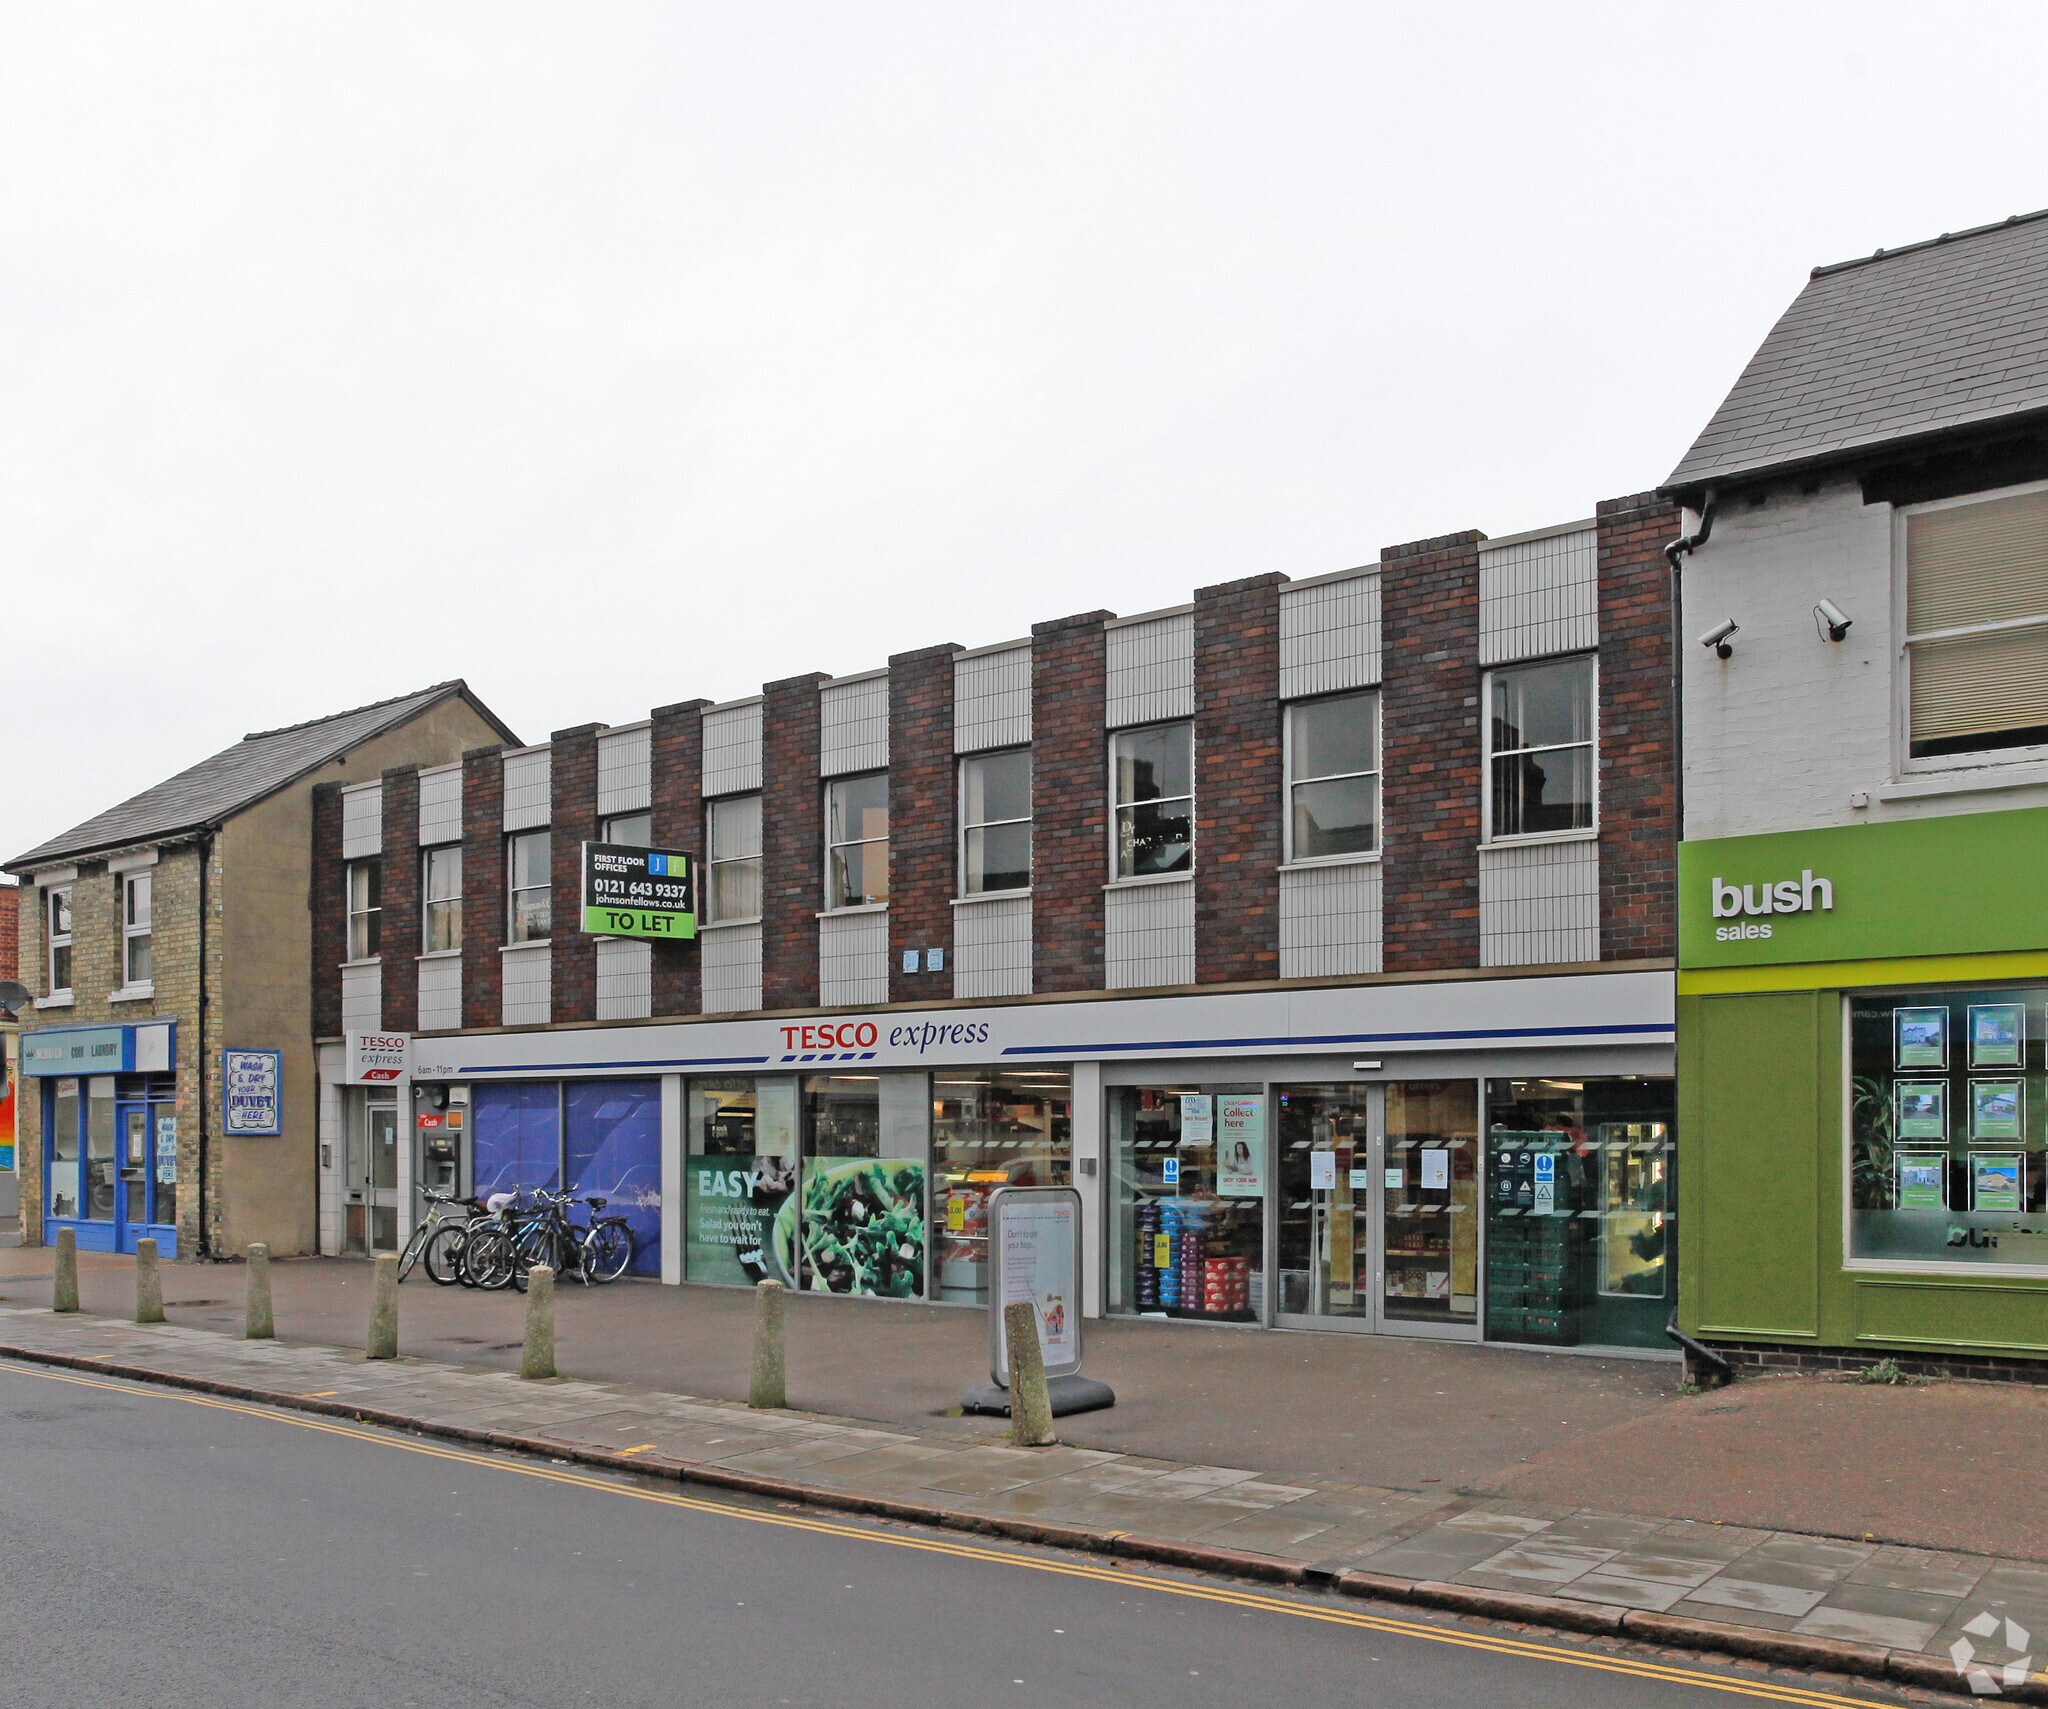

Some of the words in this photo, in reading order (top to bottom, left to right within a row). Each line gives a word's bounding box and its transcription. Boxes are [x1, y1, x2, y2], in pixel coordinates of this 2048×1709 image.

[594, 854, 616, 864] FIRST
[618, 857, 645, 867] FLOOR
[594, 862, 628, 873] OFFICES
[594, 878, 625, 894] 0121
[629, 882, 653, 896] 643
[655, 883, 687, 898] 9337
[1711, 869, 1833, 918] bush
[595, 894, 686, 909] johnsonfellows.co.uk
[606, 912, 635, 930] TO
[641, 914, 675, 932] LET
[1715, 921, 1773, 941] sales
[360, 1036, 404, 1048] TESCO
[779, 1022, 878, 1050] TESCO
[889, 1021, 989, 1054] express
[71, 1046, 85, 1059] COIN
[91, 1043, 118, 1057] LAUNDRY
[240, 1061, 264, 1071] WASH
[361, 1053, 403, 1066] express
[248, 1074, 266, 1083] DRY
[371, 1071, 390, 1080] Cash
[231, 1095, 273, 1108] DUVET
[241, 1111, 265, 1119] HERE
[1223, 1107, 1254, 1117] Collect
[424, 1118, 438, 1127] Cash
[1224, 1118, 1245, 1127] here
[698, 1170, 759, 1198] EASY
[700, 1204, 716, 1214] Fresh
[716, 1205, 730, 1214] and
[730, 1205, 750, 1217] ready
[750, 1207, 757, 1215] to
[699, 1217, 722, 1229] Salad
[723, 1220, 739, 1231] you
[740, 1219, 763, 1231] don't
[699, 1232, 719, 1242] have
[719, 1234, 729, 1243] to
[730, 1234, 748, 1245] wait
[749, 1235, 762, 1245] for
[1007, 1241, 1020, 1250] your
